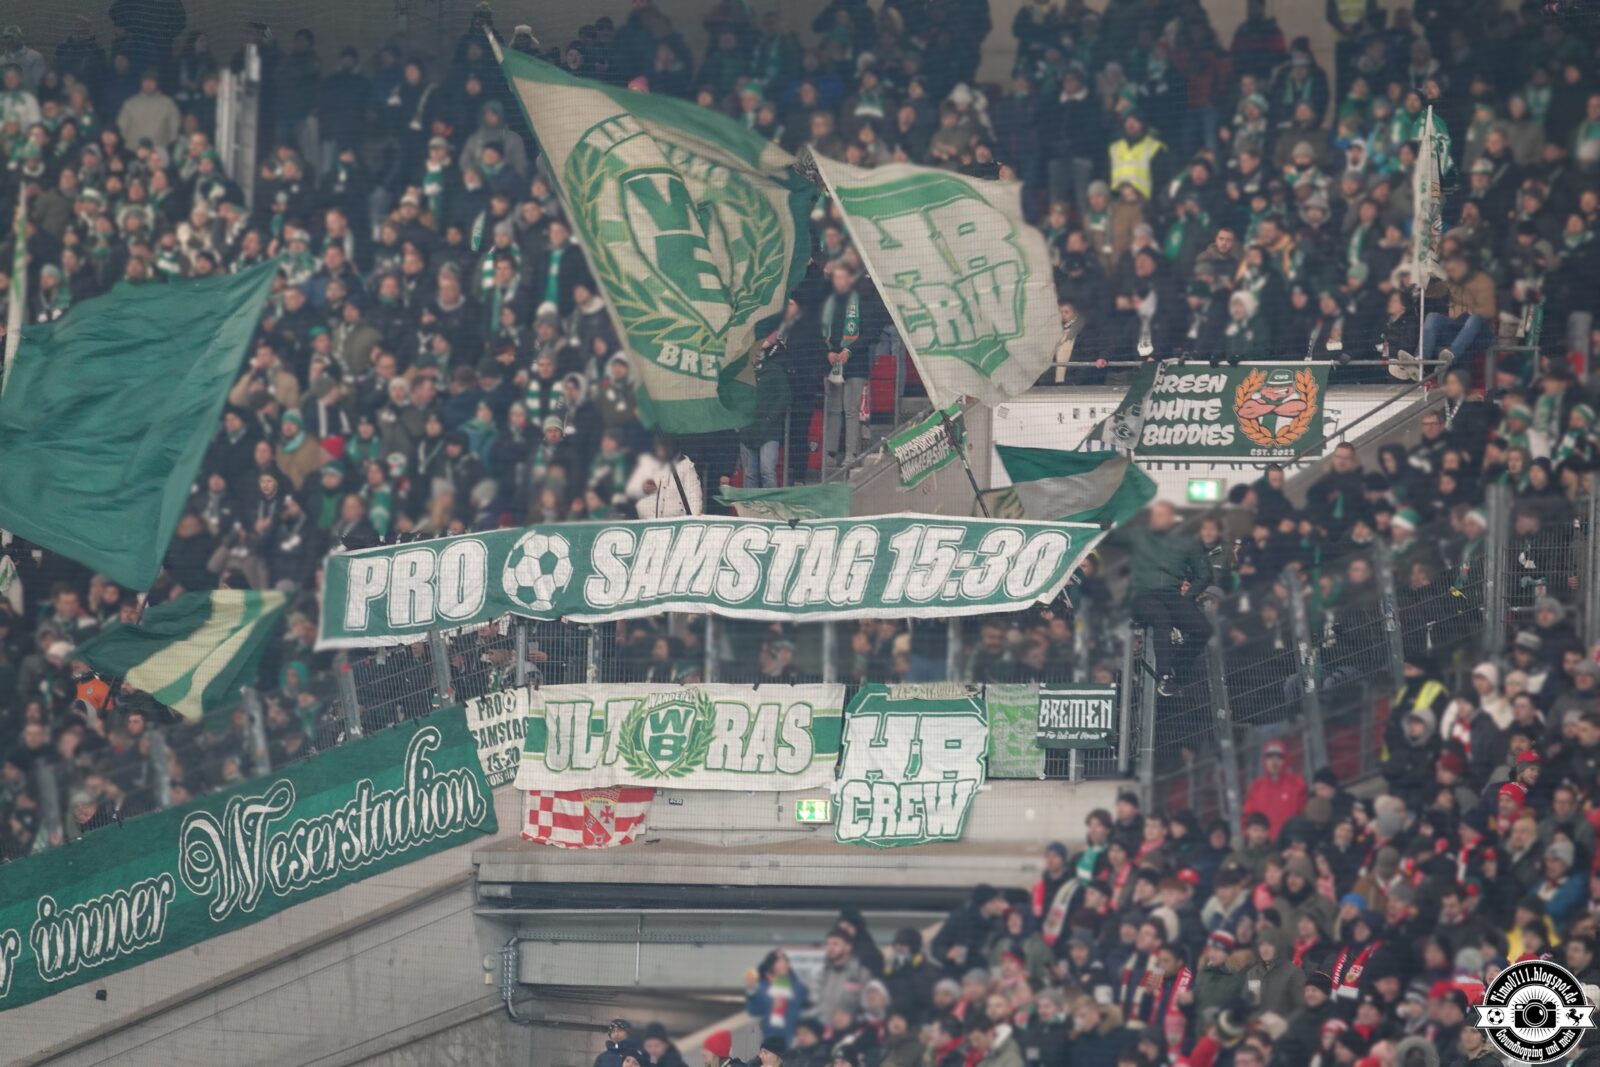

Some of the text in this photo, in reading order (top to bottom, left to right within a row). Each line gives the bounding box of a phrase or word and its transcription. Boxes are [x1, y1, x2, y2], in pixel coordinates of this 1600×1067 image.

[656, 341, 722, 379] BRE
[1144, 397, 1223, 422] WHITE
[1142, 424, 1236, 447] BUDDIES
[344, 523, 1072, 632] PRO SAMSTAG 15:30
[476, 693, 503, 721] PRO
[1038, 699, 1113, 729] BREMEN
[834, 714, 988, 780] HB
[835, 780, 978, 842] CREW
[33, 875, 174, 978] immer
[181, 727, 486, 920] Weserstadion
